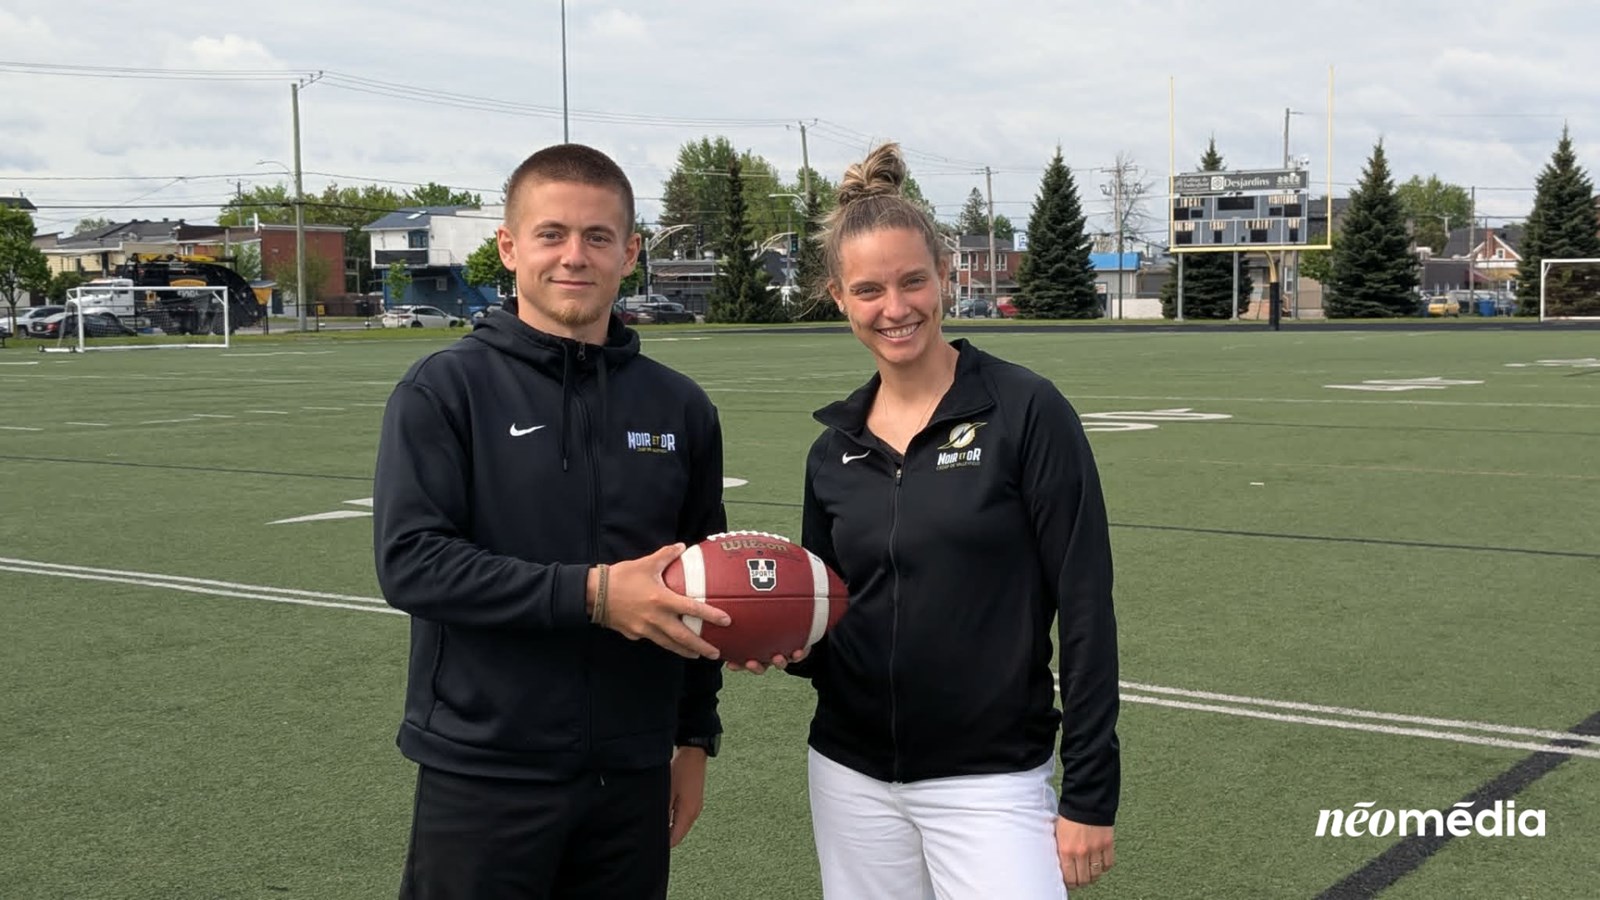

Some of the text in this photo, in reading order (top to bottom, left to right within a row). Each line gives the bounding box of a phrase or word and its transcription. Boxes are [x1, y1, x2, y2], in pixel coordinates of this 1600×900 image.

[1224, 178, 1270, 189] Desjardins
[627, 431, 651, 449] NOIR
[652, 435, 660, 445] ET
[661, 433, 676, 451] OR
[938, 448, 981, 465] NOIR ET OR
[721, 540, 787, 551] Wilson
